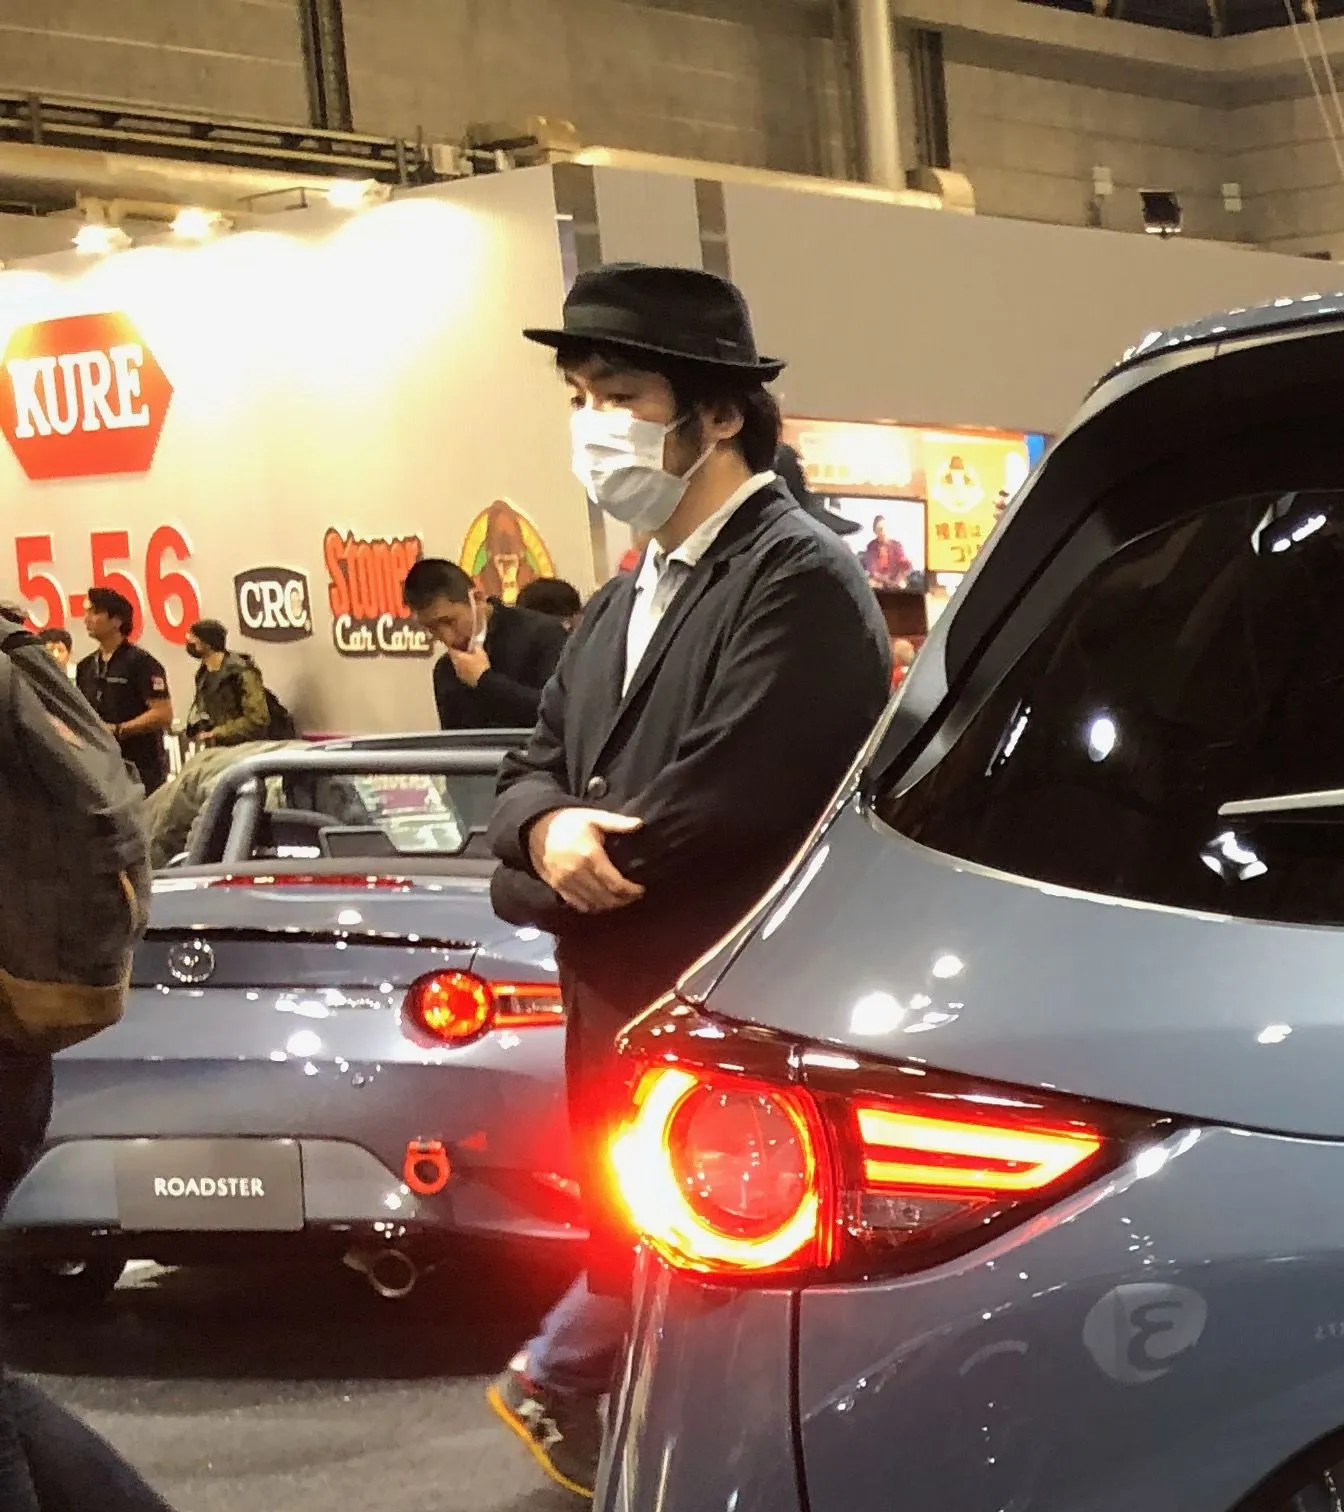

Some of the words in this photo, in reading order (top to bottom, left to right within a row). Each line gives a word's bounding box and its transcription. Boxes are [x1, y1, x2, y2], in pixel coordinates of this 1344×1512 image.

[8, 344, 150, 438] KURE
[15, 525, 201, 645] 5-56
[240, 579, 308, 629] CRC
[335, 614, 376, 651] Car
[376, 613, 430, 651] Care
[154, 1177, 265, 1197] ROADSTER
